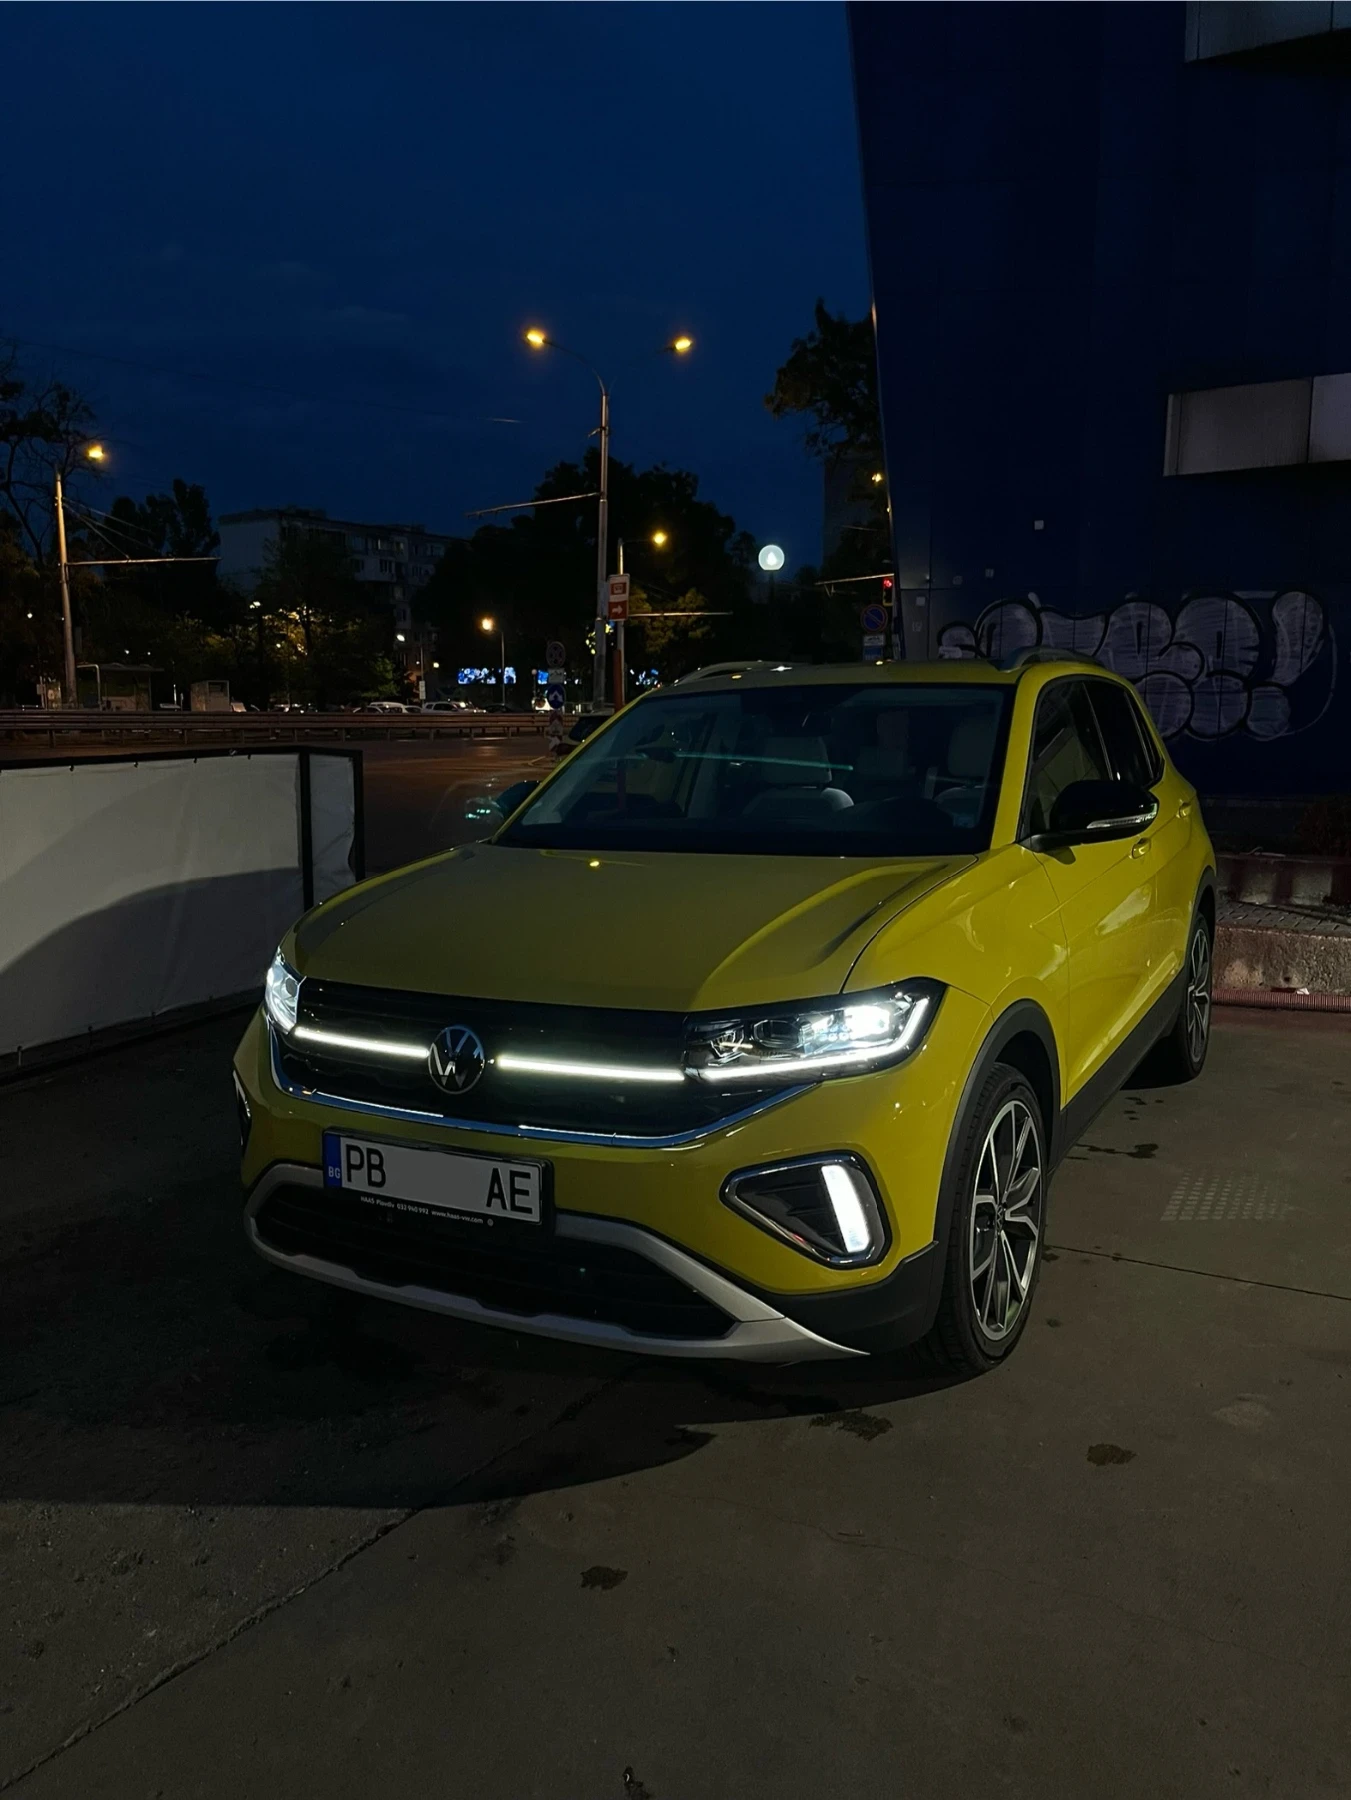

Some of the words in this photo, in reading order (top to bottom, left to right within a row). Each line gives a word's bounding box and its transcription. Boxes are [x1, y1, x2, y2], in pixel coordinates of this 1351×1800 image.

[328, 1165, 341, 1179] BG
[345, 1144, 386, 1188] PB
[486, 1167, 533, 1215] AE
[360, 1195, 375, 1205] HAAS
[397, 1202, 407, 1211] 032
[418, 1206, 429, 1215] 992
[431, 1210, 484, 1224] www.haas-vw.com
